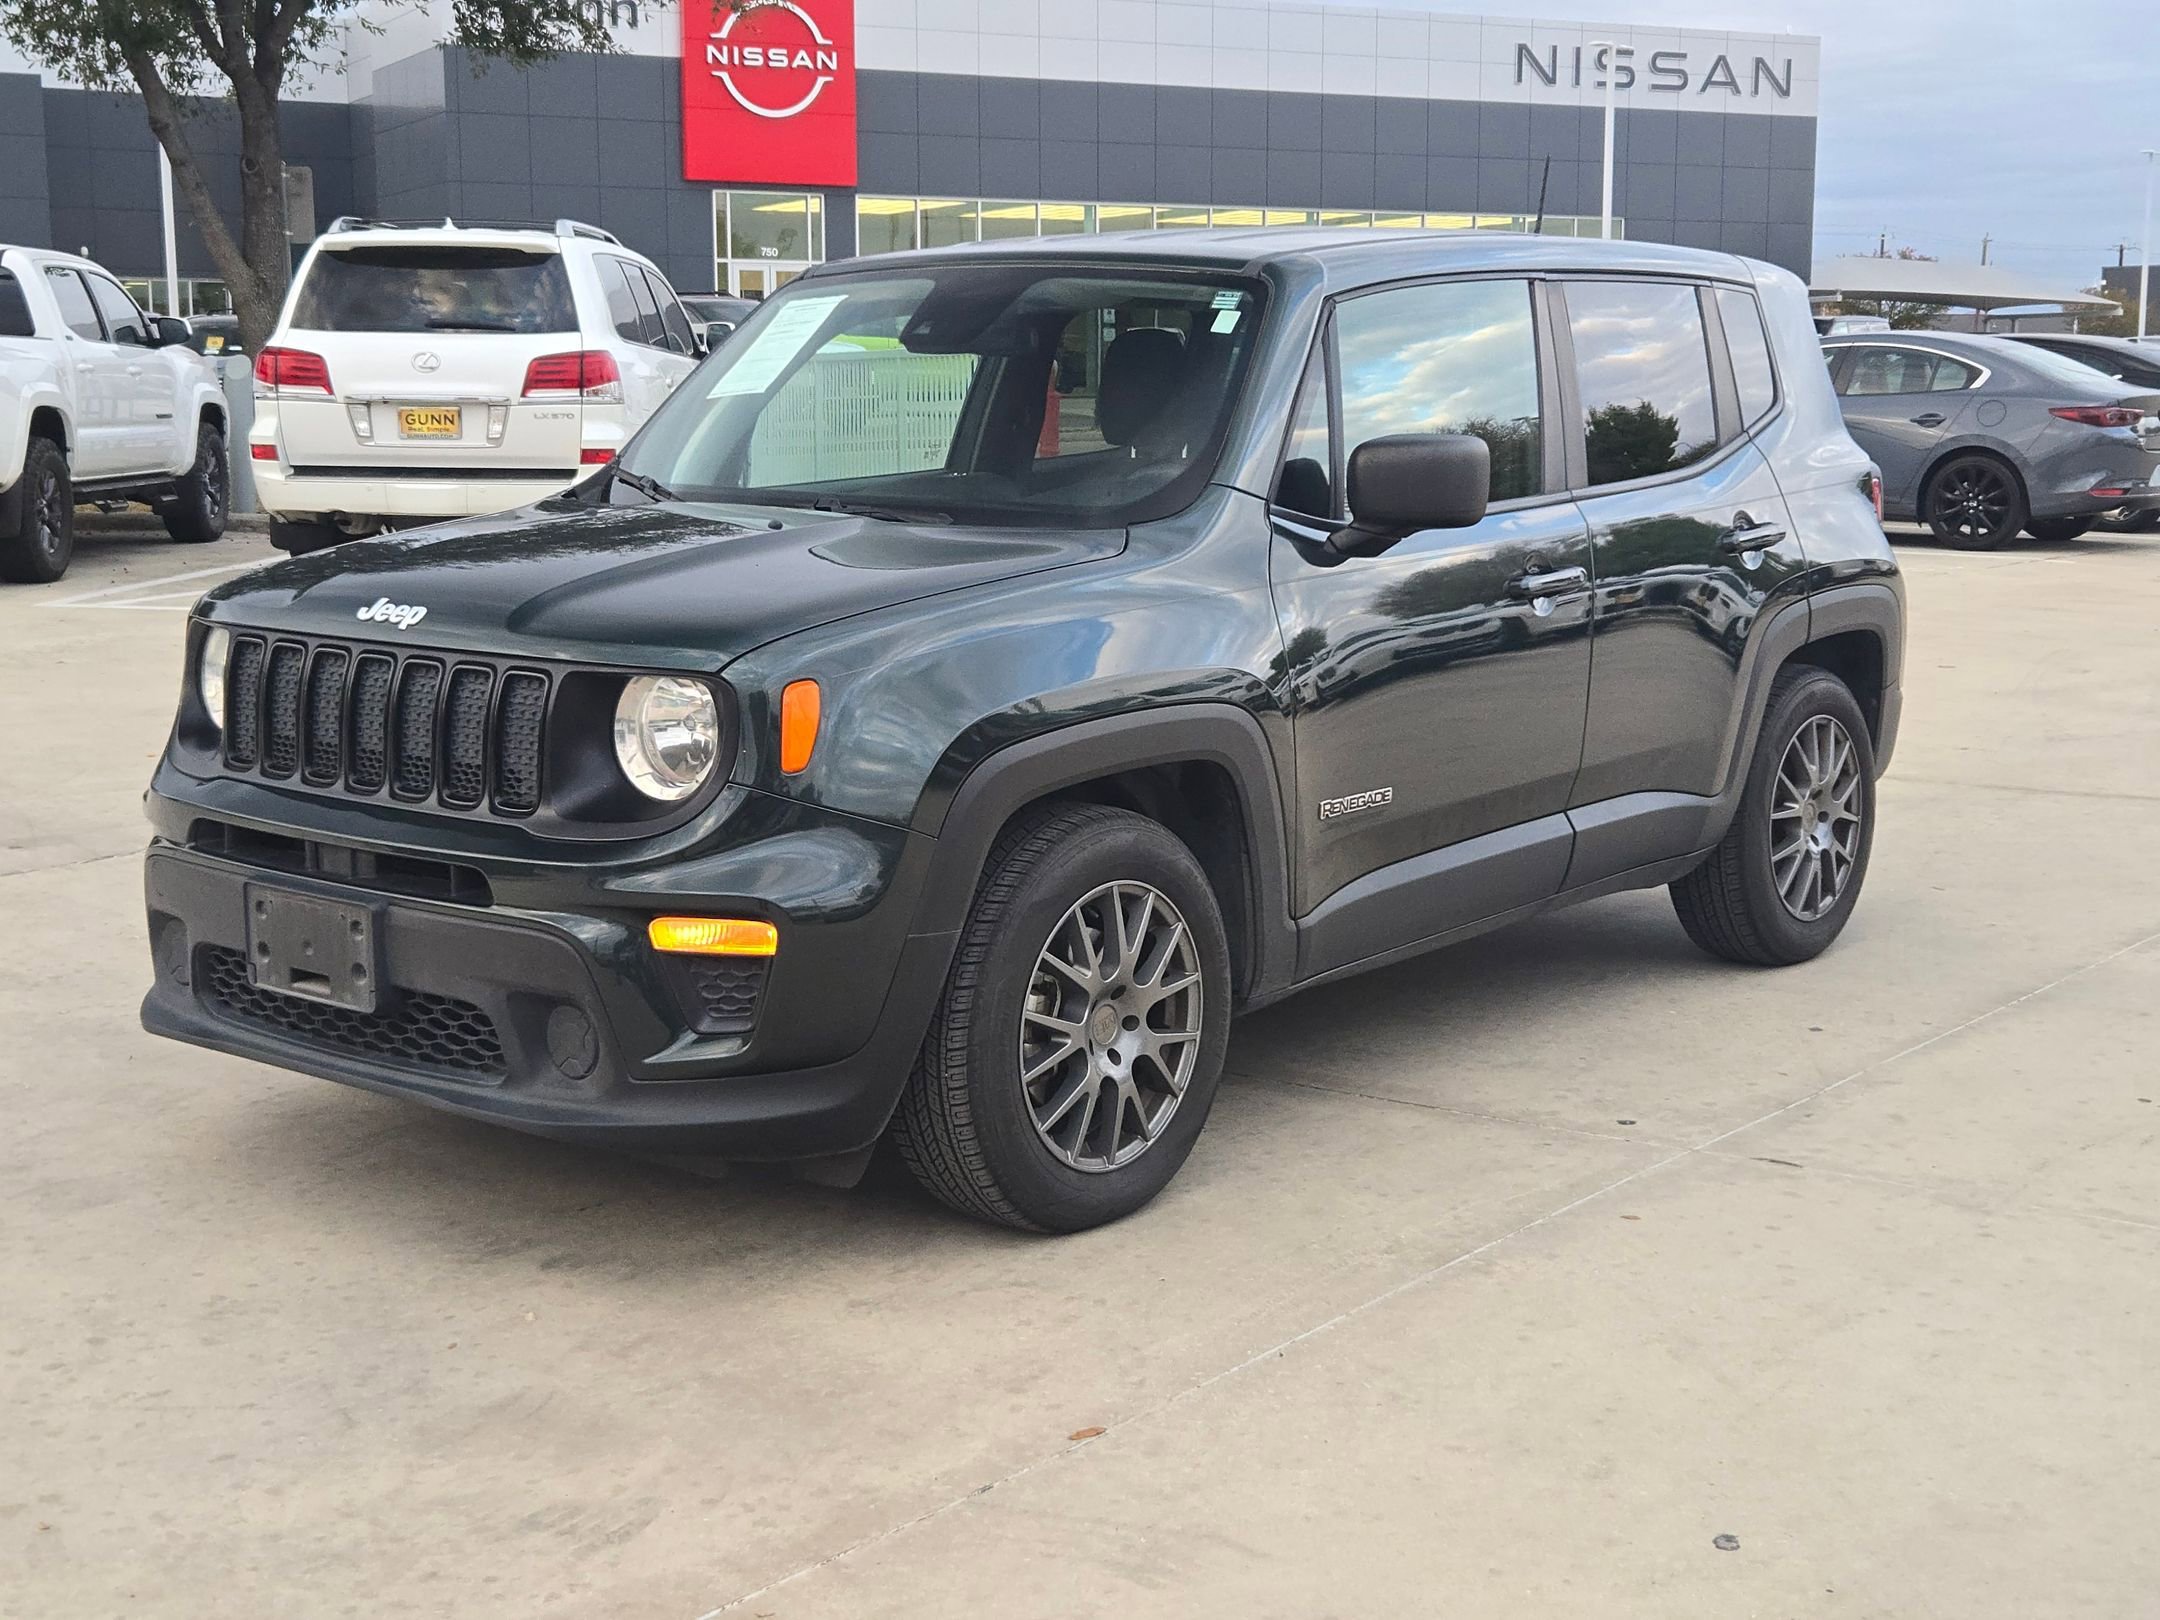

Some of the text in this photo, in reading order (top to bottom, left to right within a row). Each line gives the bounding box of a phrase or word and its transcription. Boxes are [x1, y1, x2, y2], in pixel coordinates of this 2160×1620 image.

[706, 44, 838, 70] NISSAN
[1514, 43, 1792, 98] NISSAN
[760, 246, 779, 257] 750
[405, 413, 455, 426] GUNN
[356, 597, 428, 631] Jeep
[1318, 787, 1393, 820] RENEGADE
